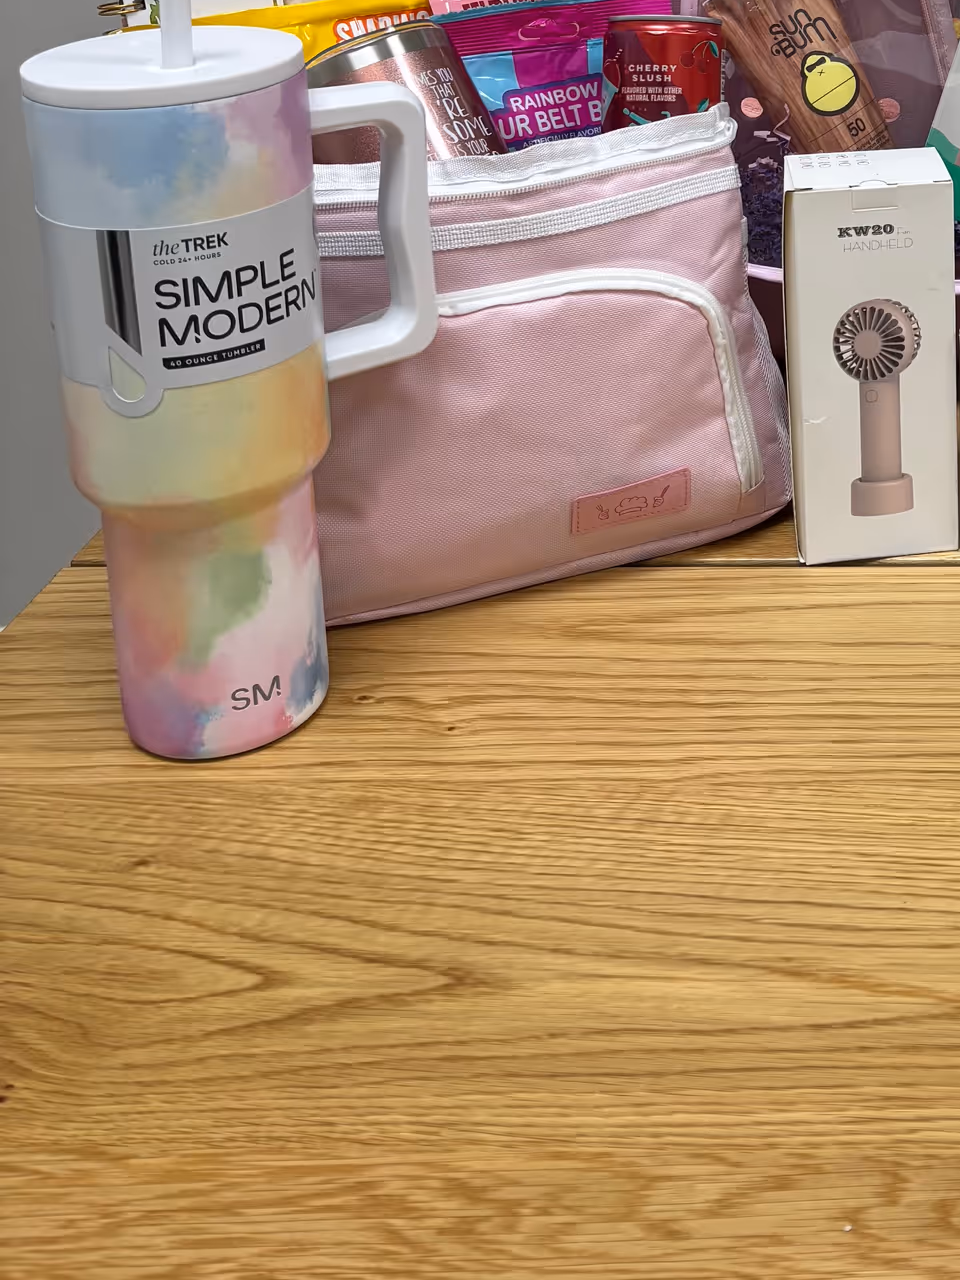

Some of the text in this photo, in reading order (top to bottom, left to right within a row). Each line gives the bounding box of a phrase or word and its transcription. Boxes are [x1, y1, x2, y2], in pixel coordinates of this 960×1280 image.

[435, 66, 454, 83] YOU
[628, 63, 678, 72] CHERRY
[632, 74, 672, 82] SLUSH
[430, 82, 456, 99] THAT
[509, 81, 599, 113] RAINBOW
[621, 86, 683, 95] FLAVORED WITH OTHER
[626, 94, 677, 102] NATURAL FLAVORS
[534, 103, 582, 133] BELT
[846, 116, 867, 138] 50
[454, 143, 465, 157] IS
[465, 137, 490, 156] YOUR
[837, 223, 895, 238] KW20
[152, 231, 230, 257] the TREK
[843, 237, 914, 253] HANDHELD
[153, 251, 222, 266] COLD 24+ HOURS
[154, 247, 297, 310] SIMPLE
[158, 269, 317, 348] MODERN
[170, 342, 262, 368] 40 OUNCE TUMBLER
[230, 674, 283, 711] SM
